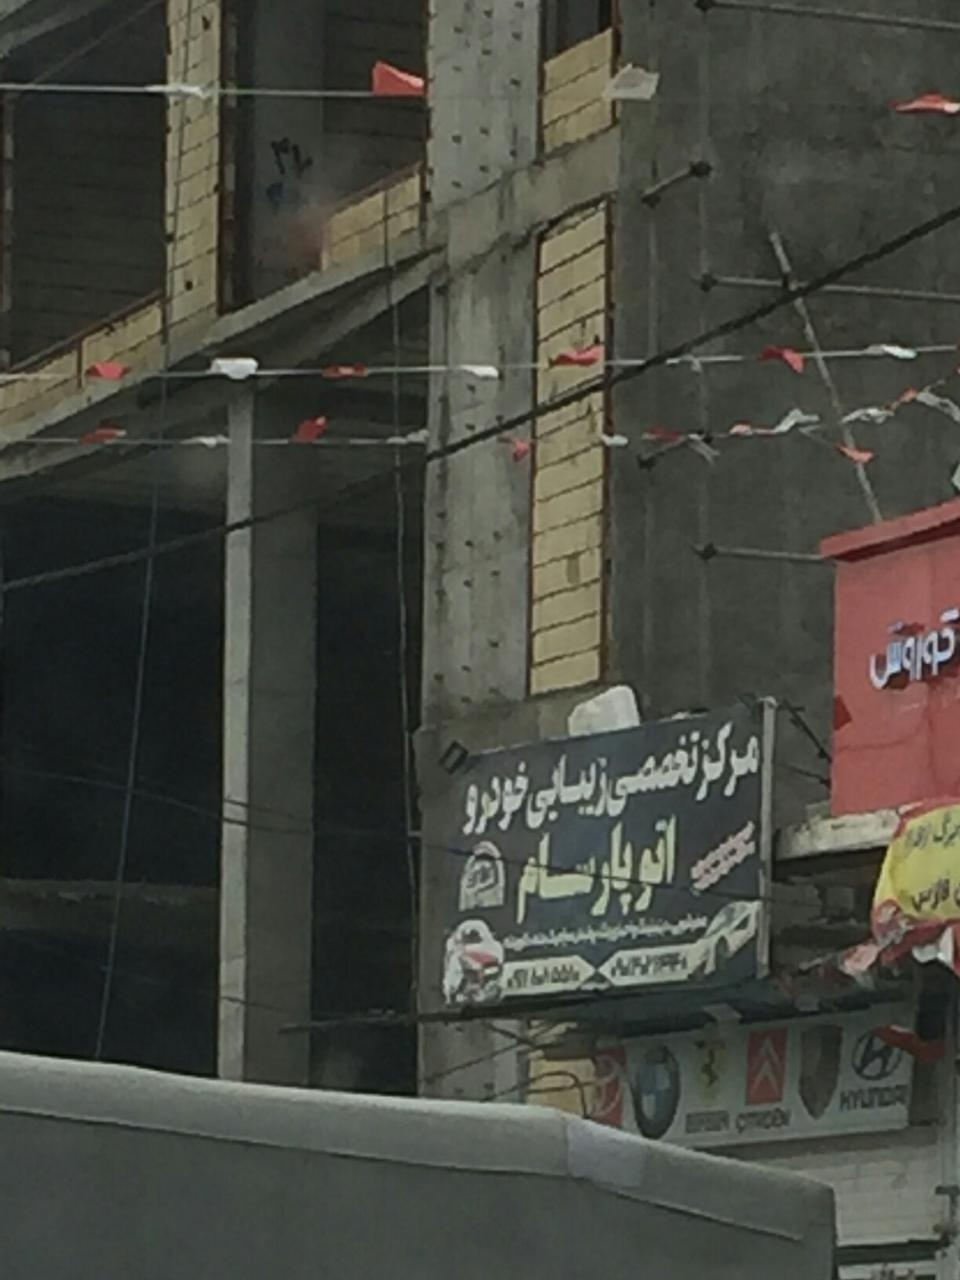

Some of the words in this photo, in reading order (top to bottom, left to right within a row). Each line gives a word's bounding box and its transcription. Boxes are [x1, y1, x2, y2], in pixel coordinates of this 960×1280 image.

[463, 761, 529, 835] خودرو
[526, 755, 608, 829] زیبایی
[607, 732, 700, 816] تخصصی
[695, 722, 760, 801] مرکز
